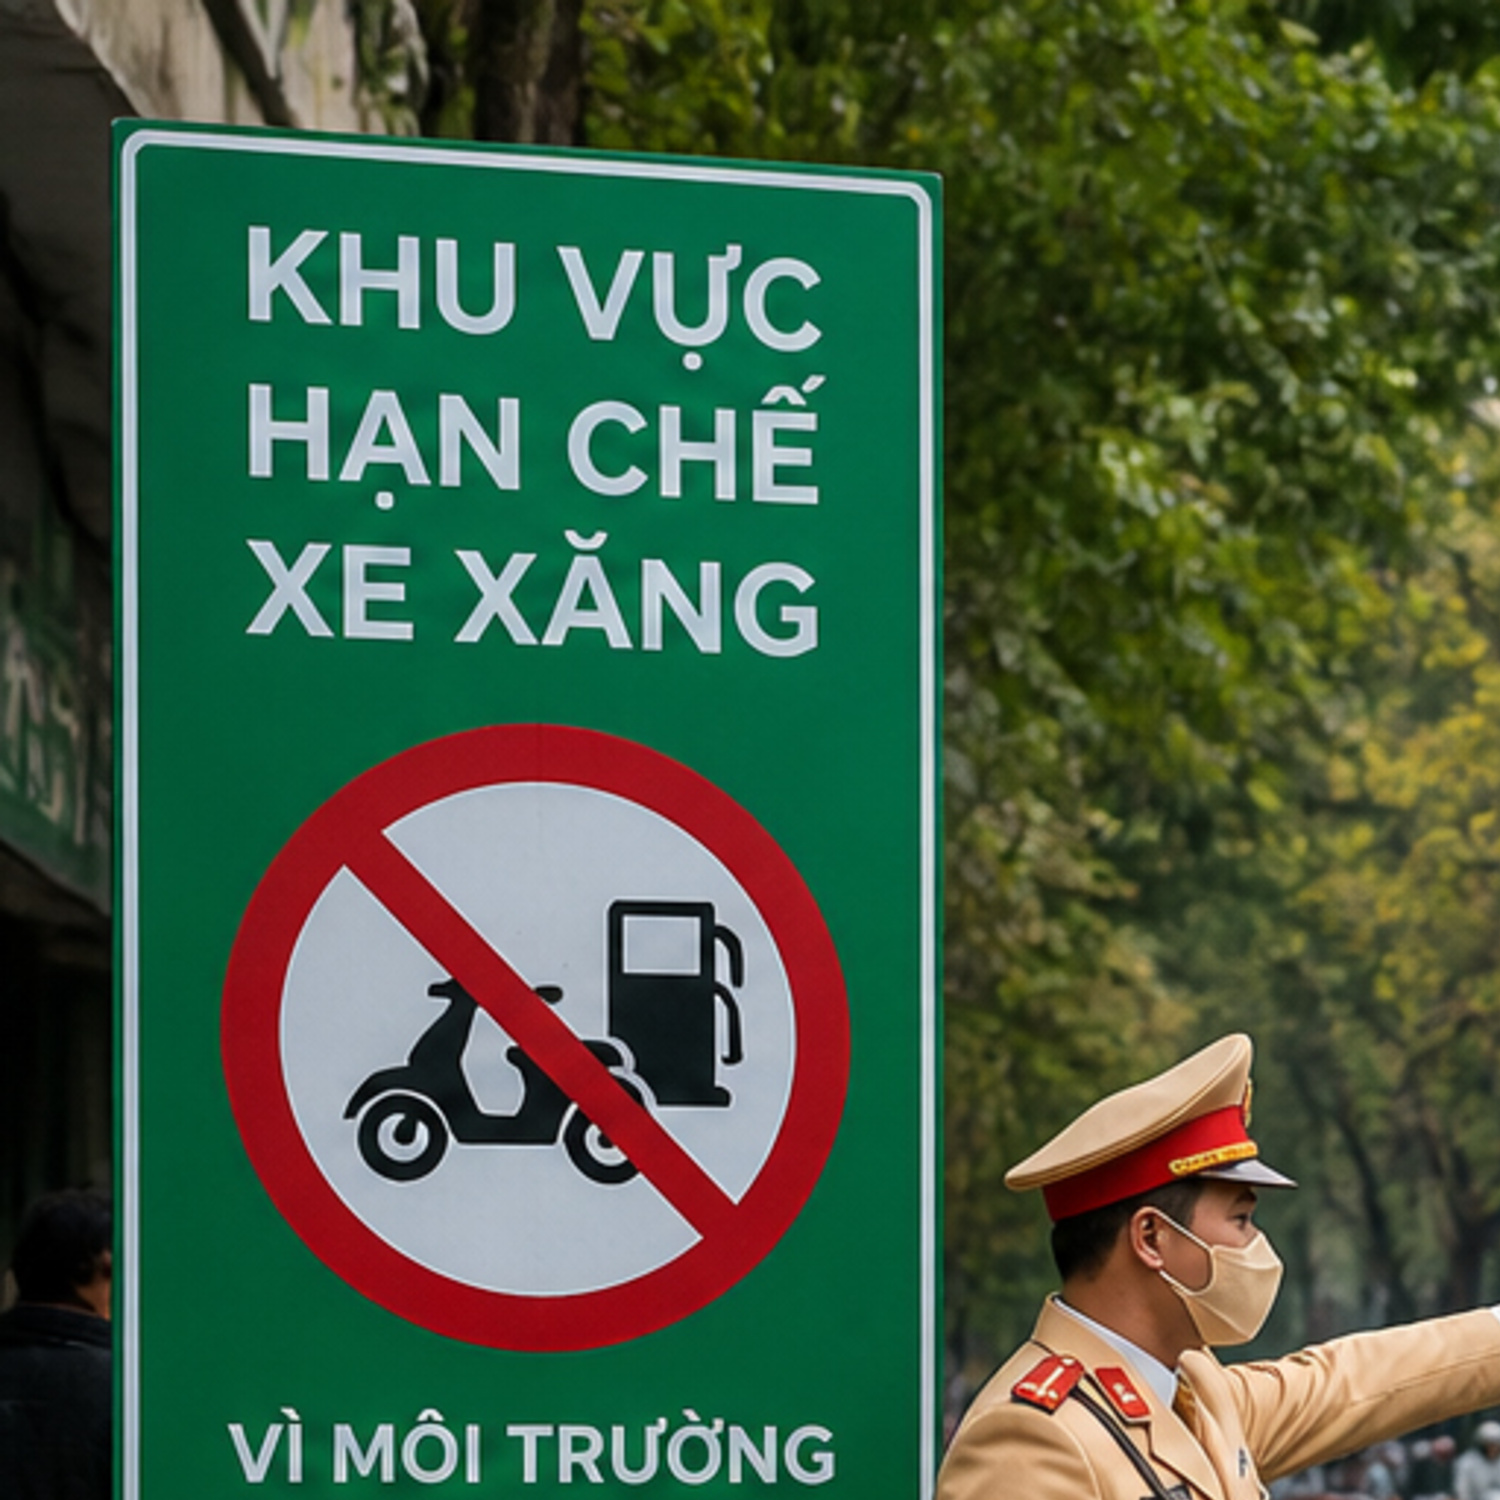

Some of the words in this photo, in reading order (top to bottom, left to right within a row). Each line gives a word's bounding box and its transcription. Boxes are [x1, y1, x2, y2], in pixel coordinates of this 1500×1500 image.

[248, 225, 517, 335] KHU
[557, 244, 823, 371] VỰC
[248, 383, 521, 510] HẠN
[567, 374, 827, 505] CHẾ
[245, 539, 414, 640] XE
[454, 529, 819, 658] XĂNG
[227, 1407, 302, 1483] VÌ
[333, 1408, 481, 1484] MÔI
[506, 1408, 836, 1485] TRƯỜNG
